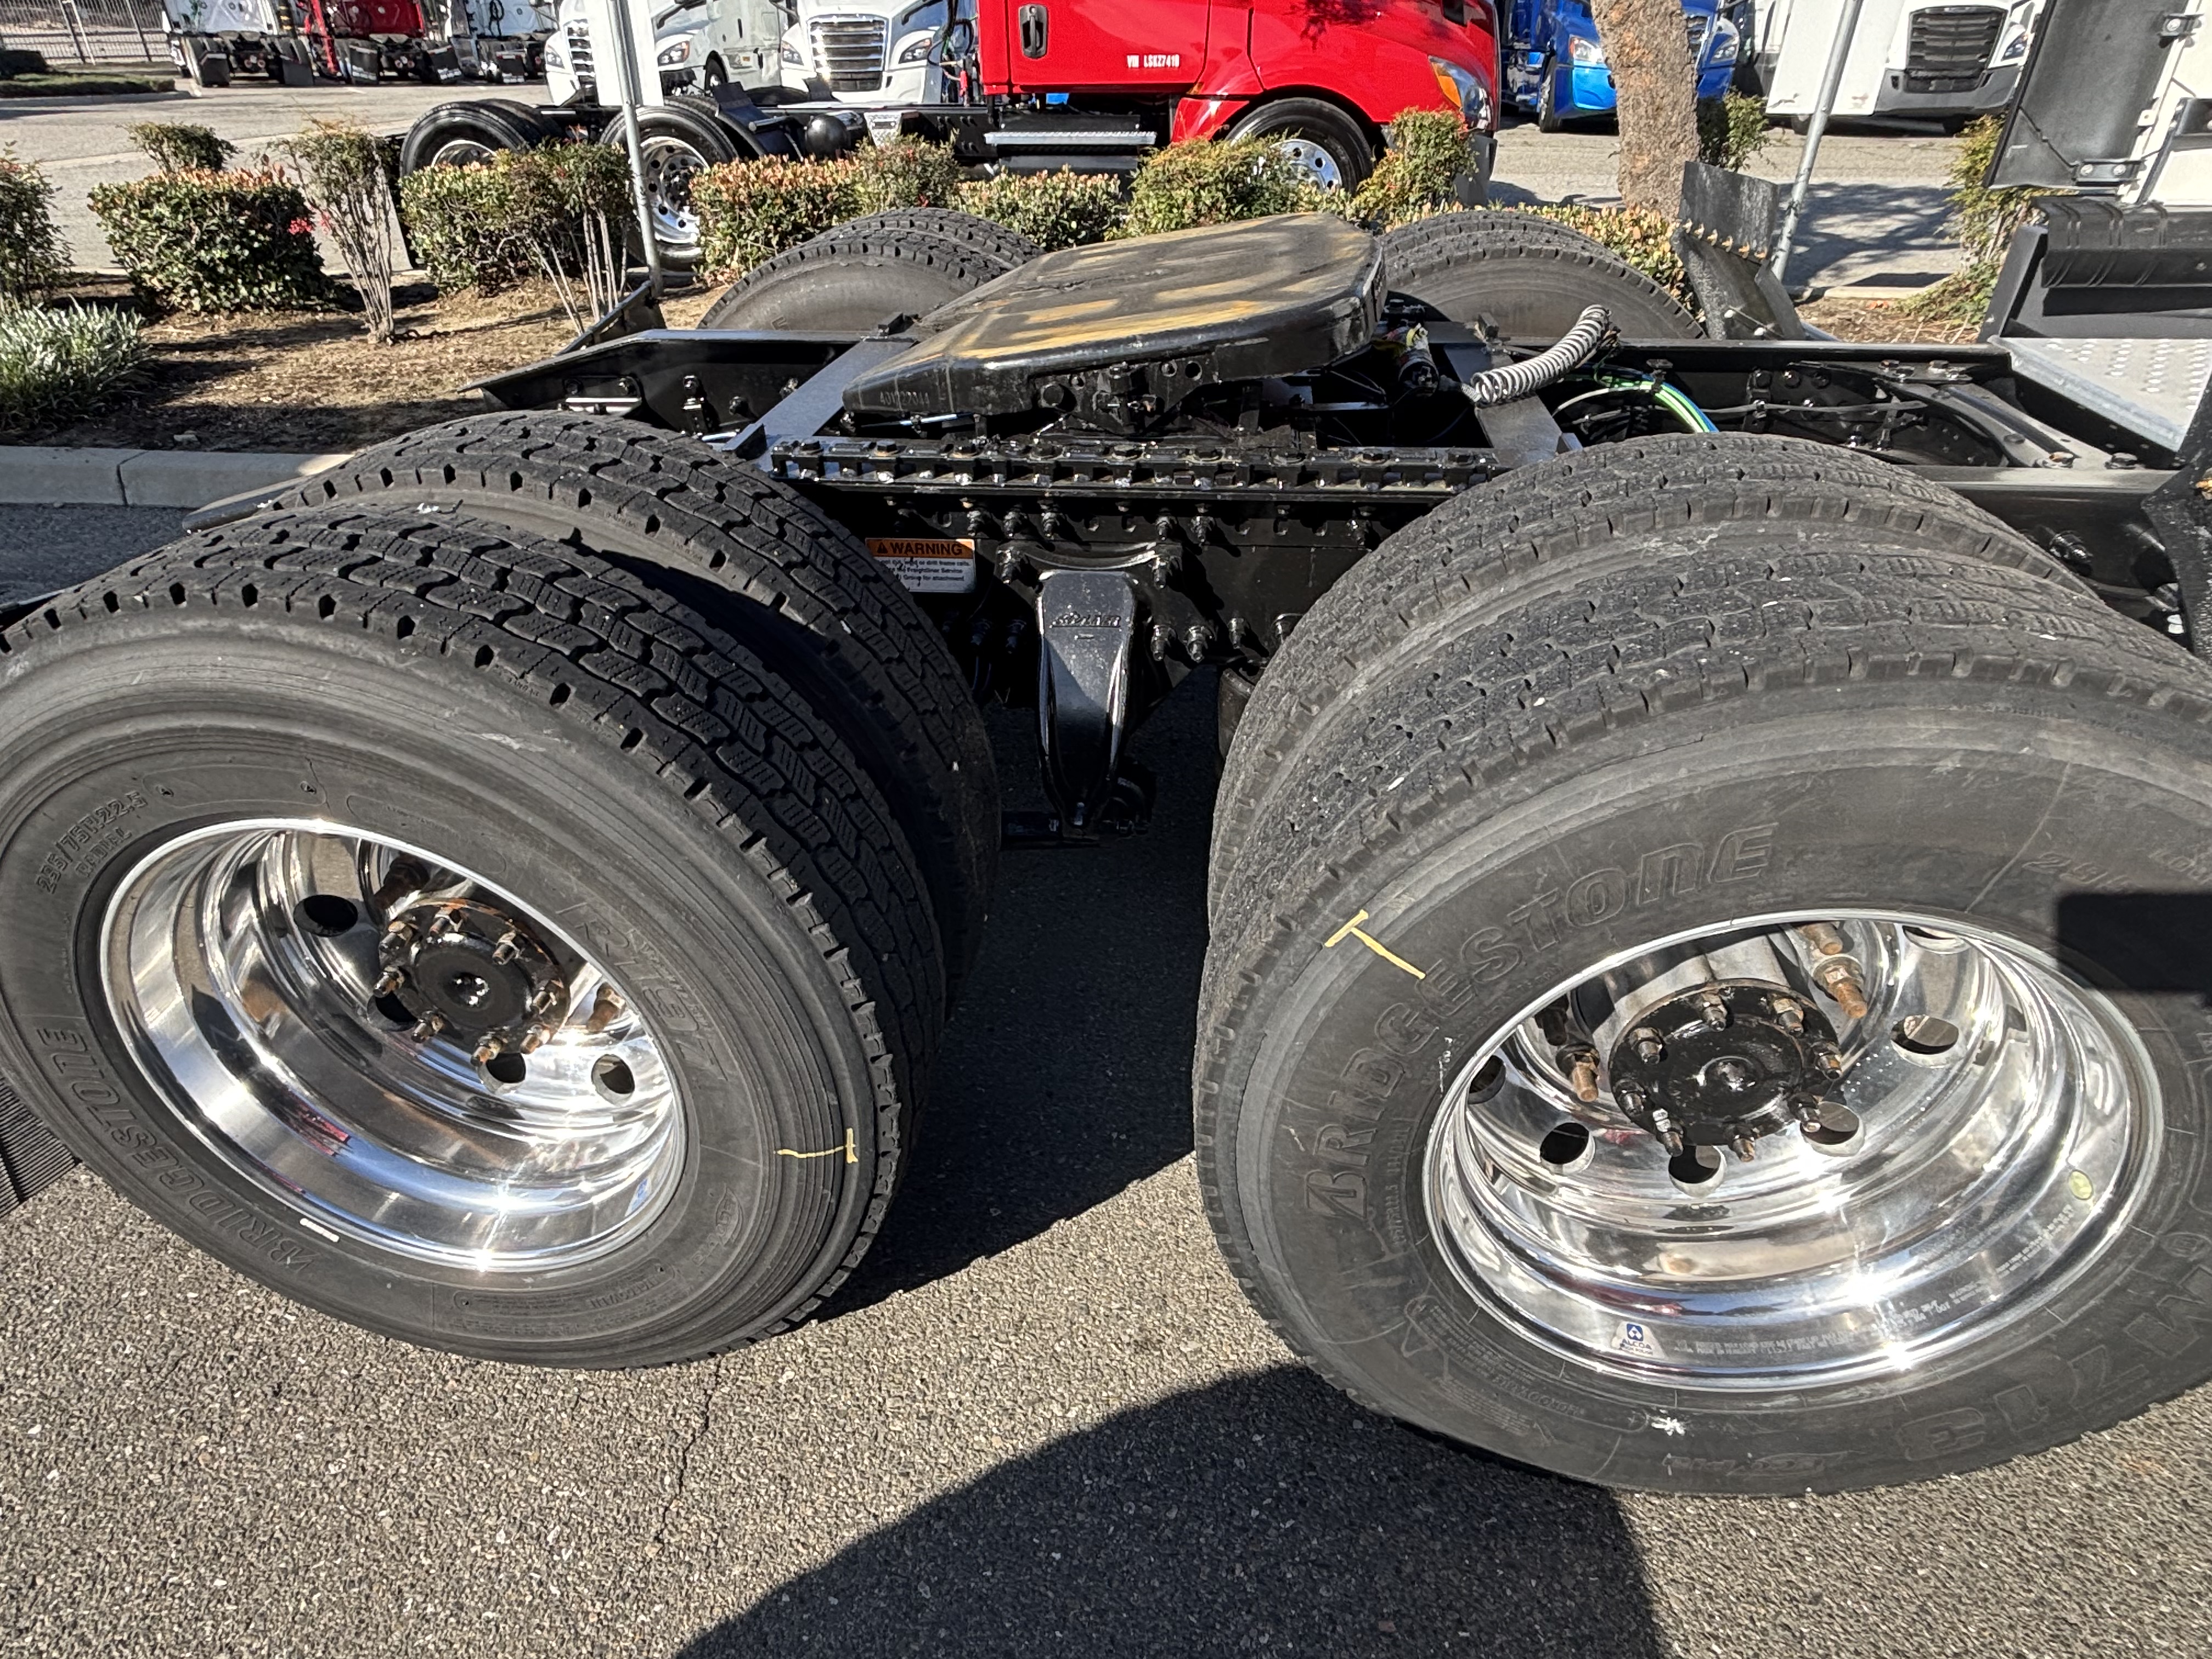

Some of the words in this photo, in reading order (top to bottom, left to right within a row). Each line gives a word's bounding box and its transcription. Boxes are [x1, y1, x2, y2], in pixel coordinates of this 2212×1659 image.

[890, 542, 962, 556] WARNING
[1305, 822, 1779, 1220] BRIDGESTONE
[36, 1027, 318, 1275] BRIDGESTONE
